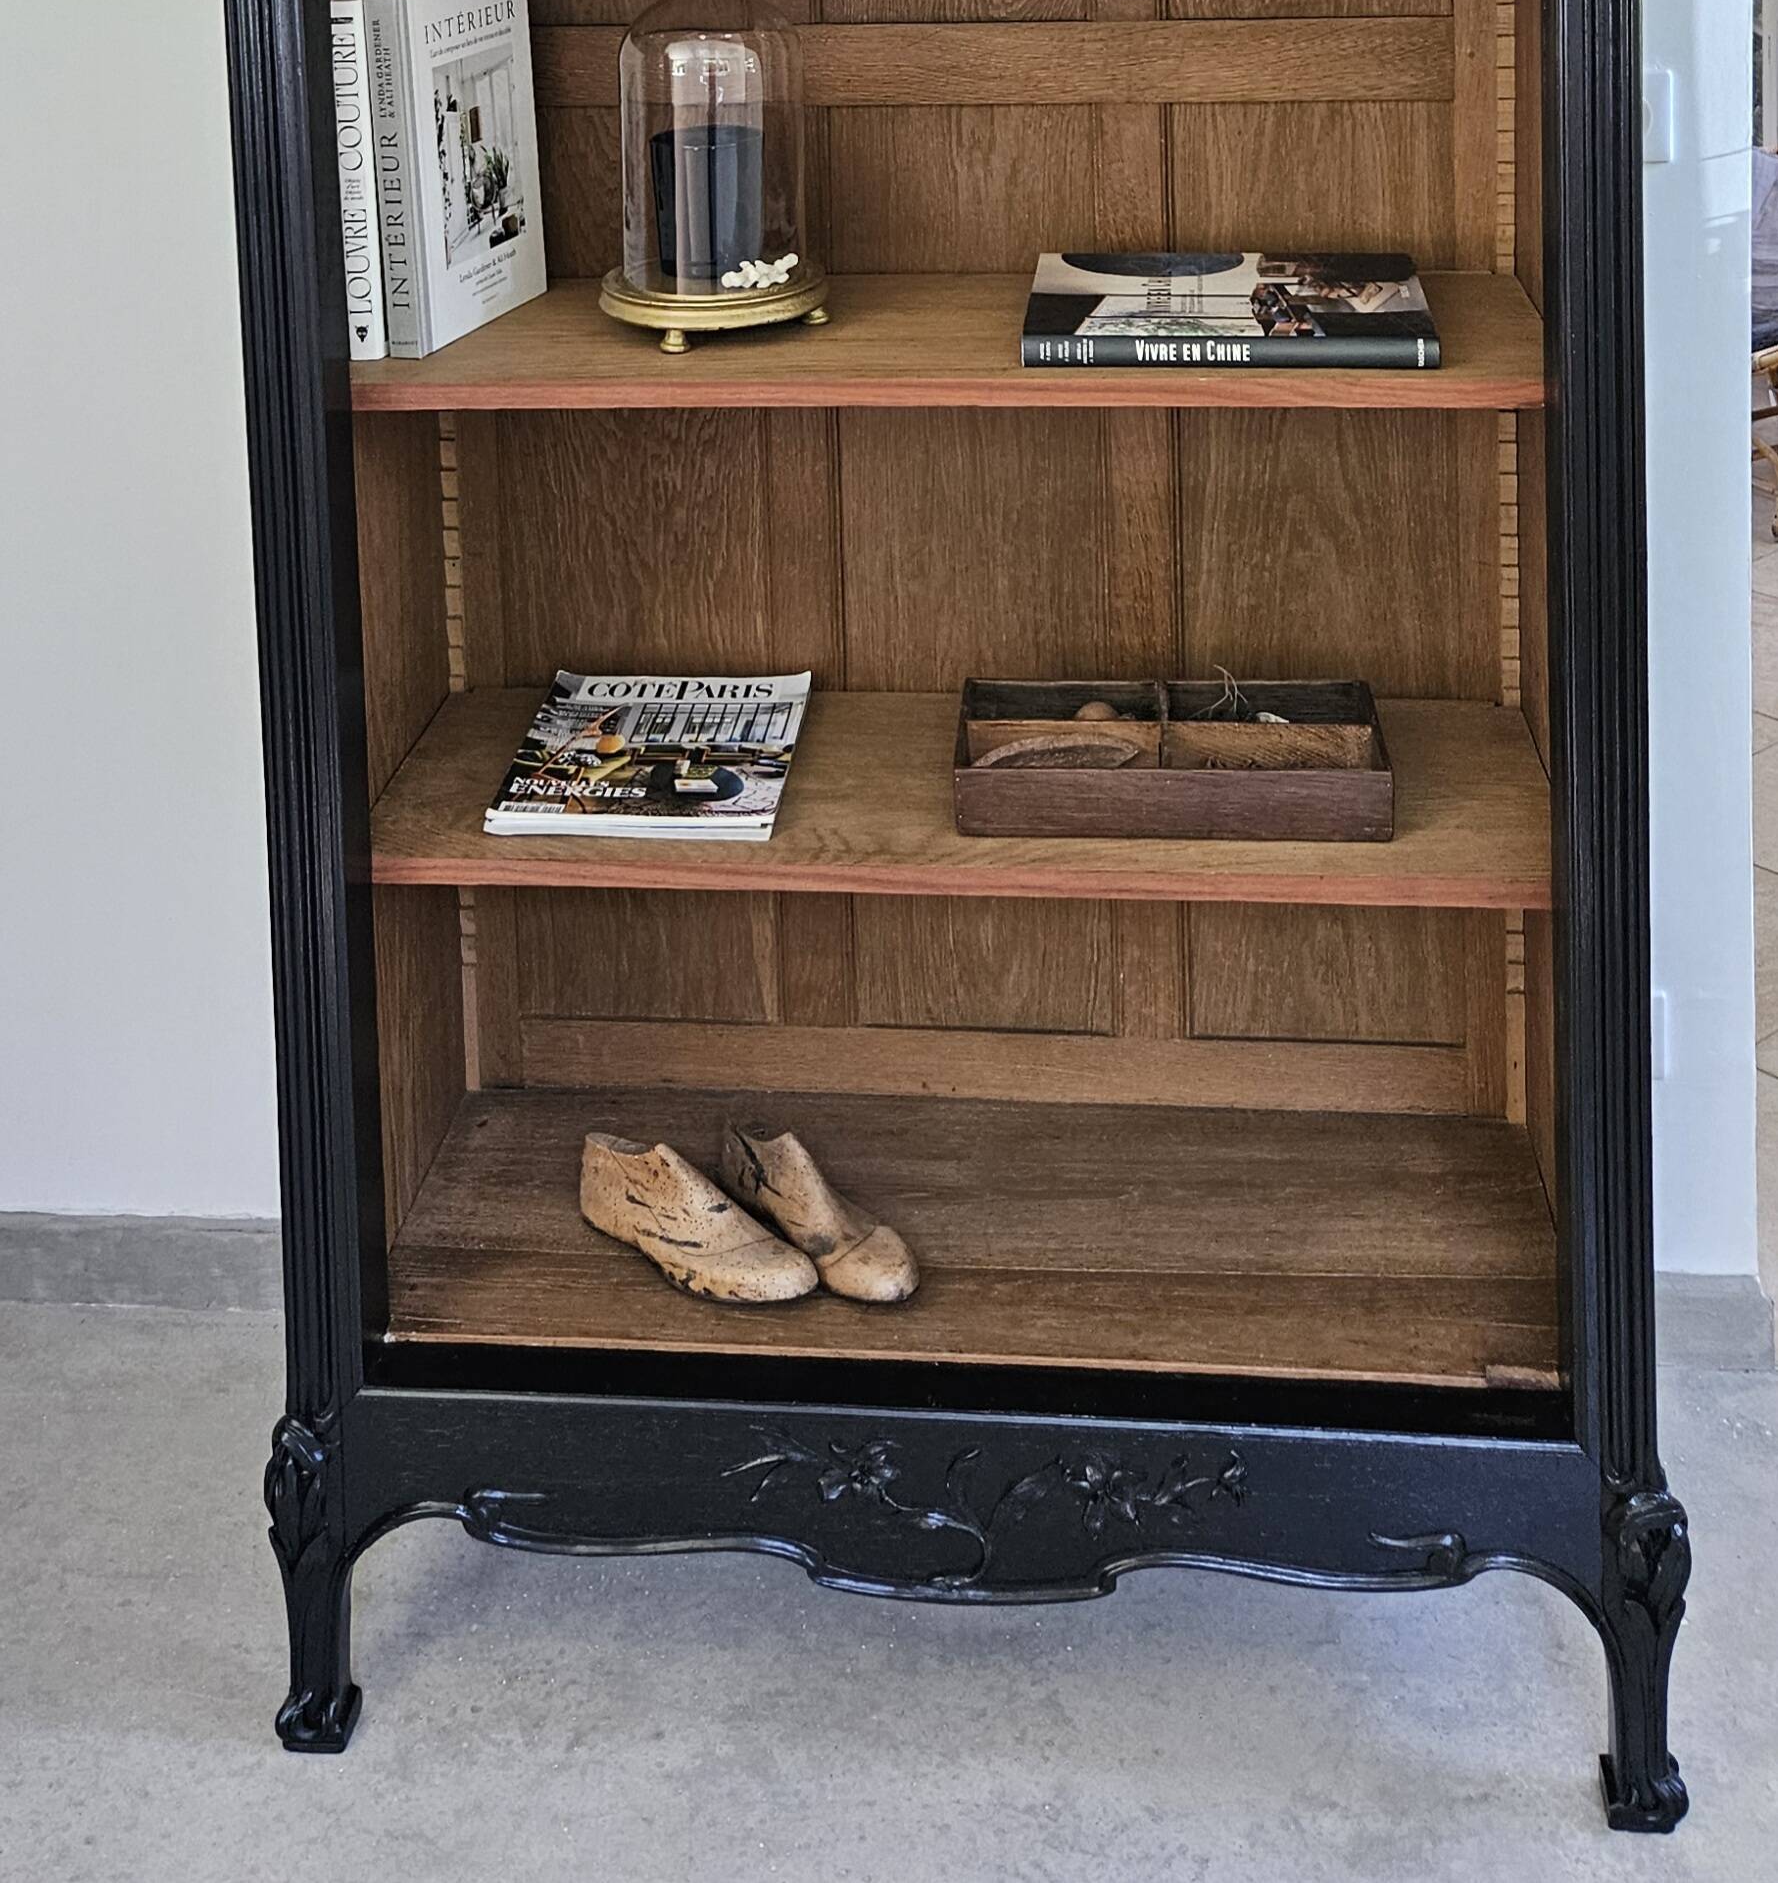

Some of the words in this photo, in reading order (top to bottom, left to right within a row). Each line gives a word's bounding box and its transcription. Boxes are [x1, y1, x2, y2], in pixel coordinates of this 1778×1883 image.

[424, 0, 516, 44] INTÉRIEUR
[372, 19, 384, 78] GARDENER
[382, 47, 393, 86] HEATH
[331, 32, 364, 171] COUTURE
[377, 84, 388, 118] LYNDA
[387, 110, 396, 119] &
[380, 131, 410, 309] INTÉRIEUR
[343, 208, 373, 316] LOUVRE
[1135, 339, 1177, 362] VIVRE
[1182, 343, 1200, 362] EN
[1206, 339, 1250, 362] CHINE
